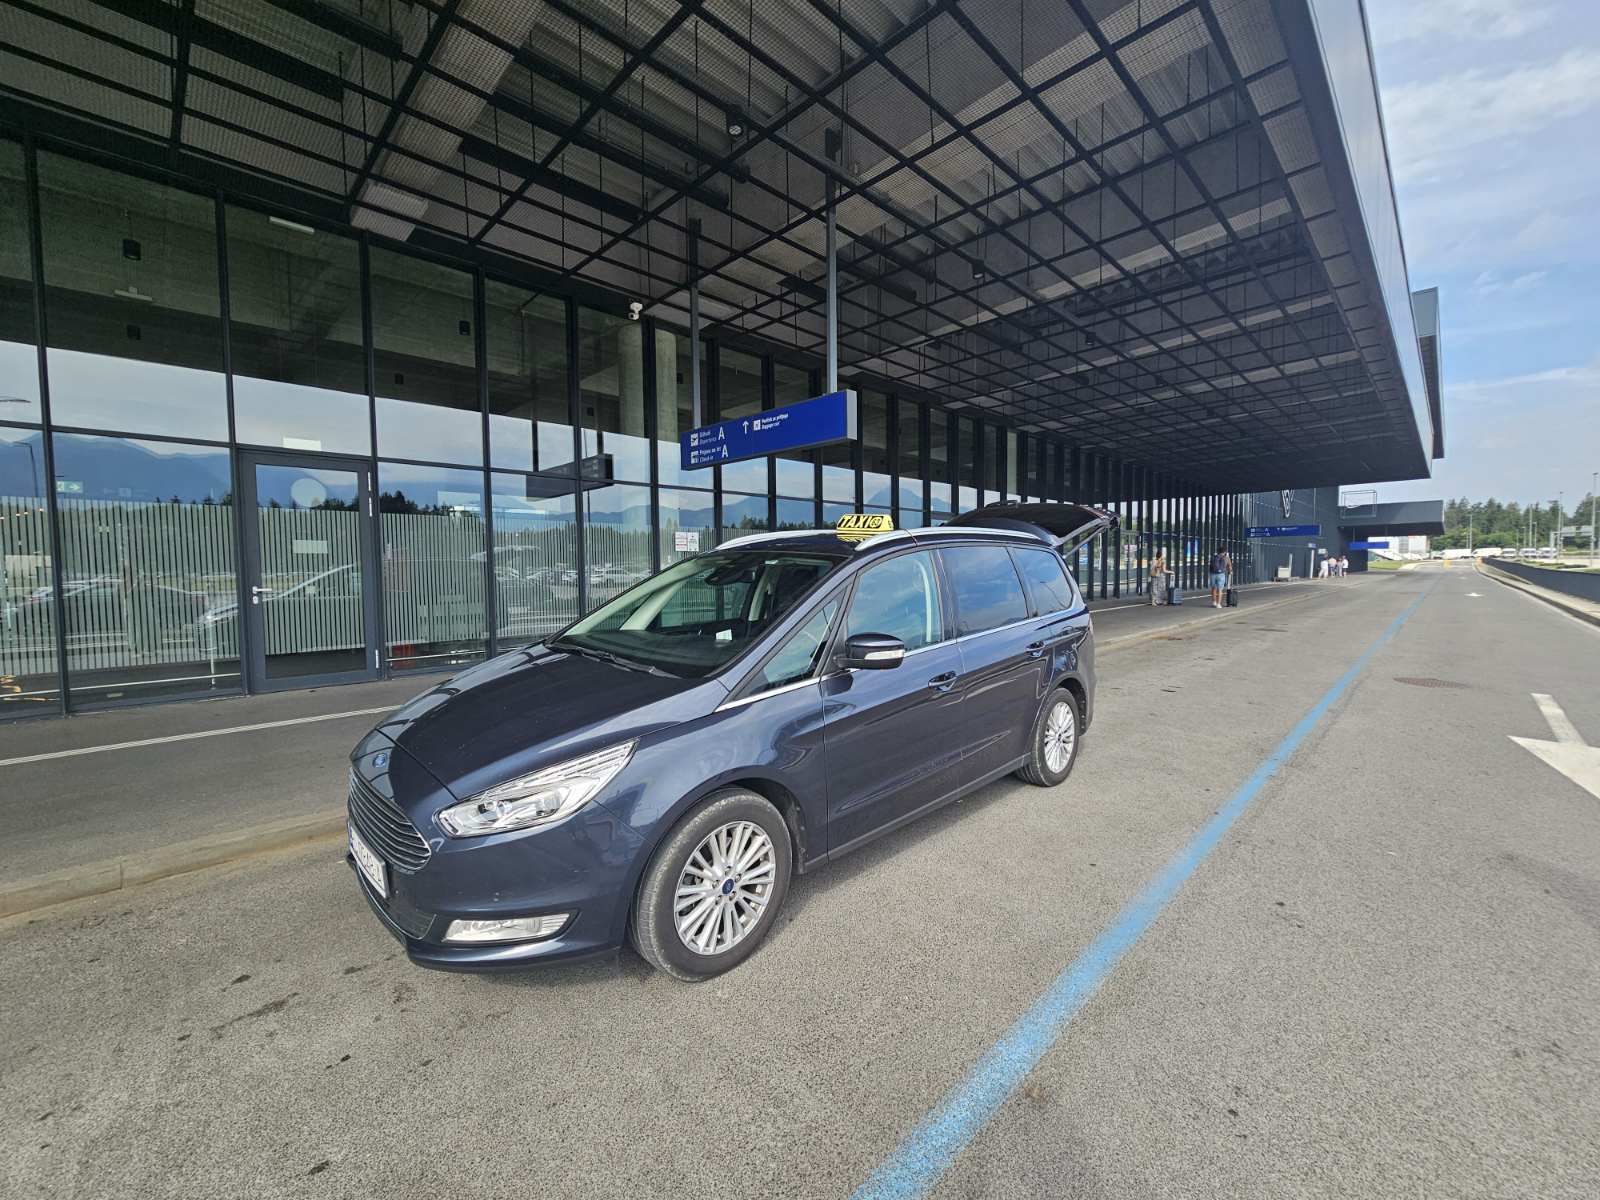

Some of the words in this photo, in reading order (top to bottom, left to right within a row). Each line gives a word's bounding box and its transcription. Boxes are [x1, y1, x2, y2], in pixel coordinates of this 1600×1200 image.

[718, 426, 725, 440] A
[722, 444, 728, 458] A
[840, 515, 873, 528] TAXI
